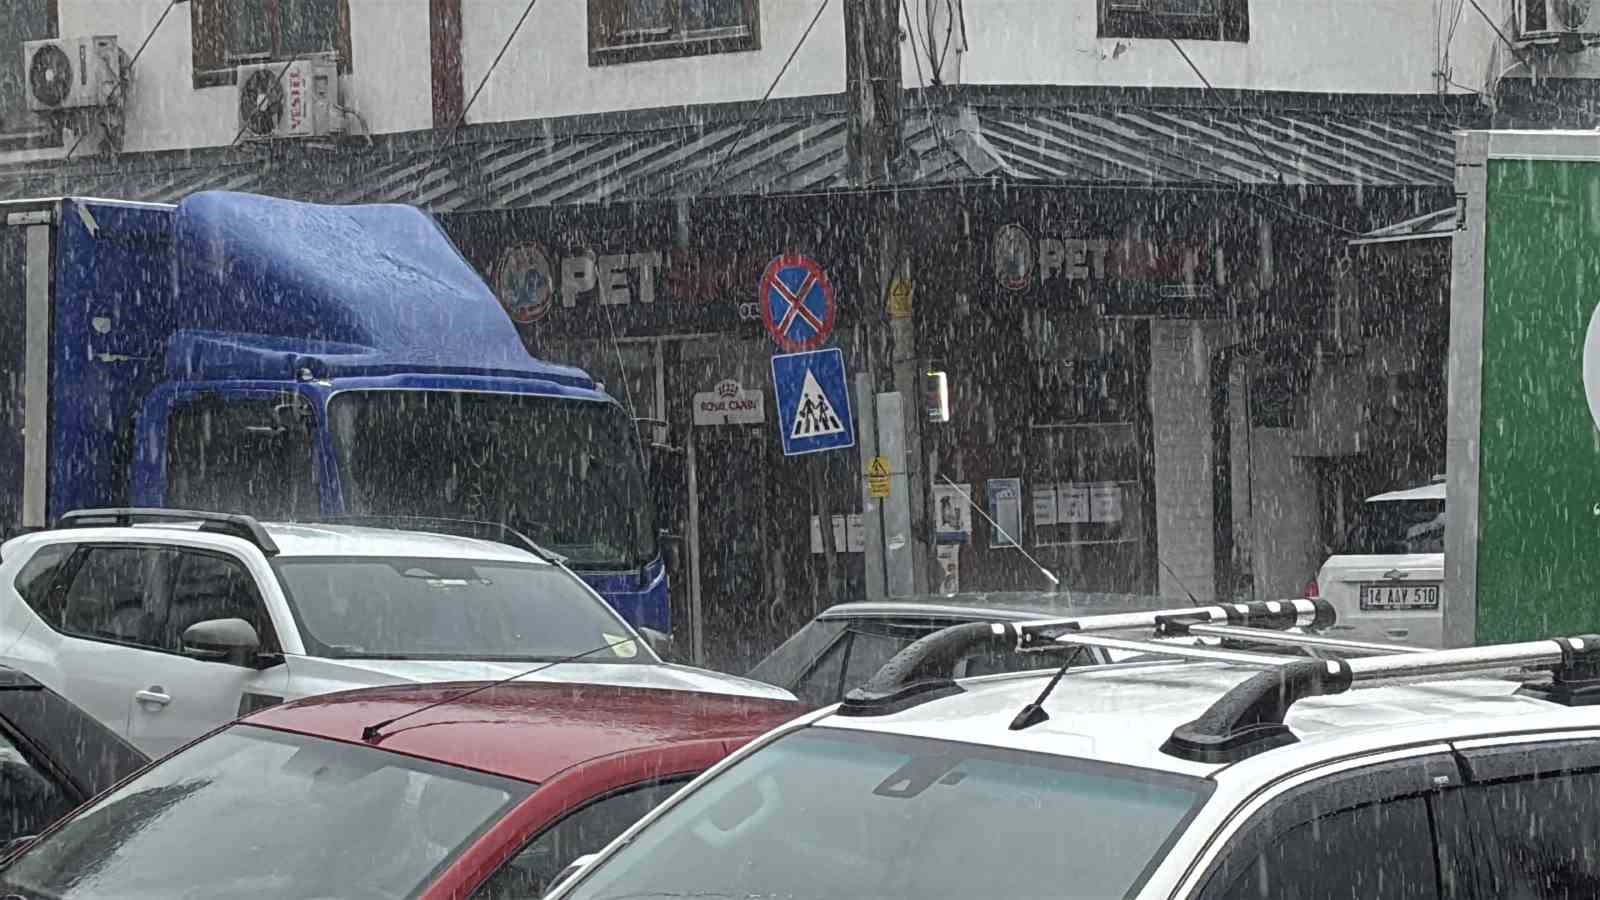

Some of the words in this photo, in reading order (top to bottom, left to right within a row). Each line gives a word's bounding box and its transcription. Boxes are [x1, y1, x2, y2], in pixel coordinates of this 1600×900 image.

[561, 251, 661, 307] PET
[1039, 239, 1106, 280] PET
[1414, 588, 1435, 603] 510
